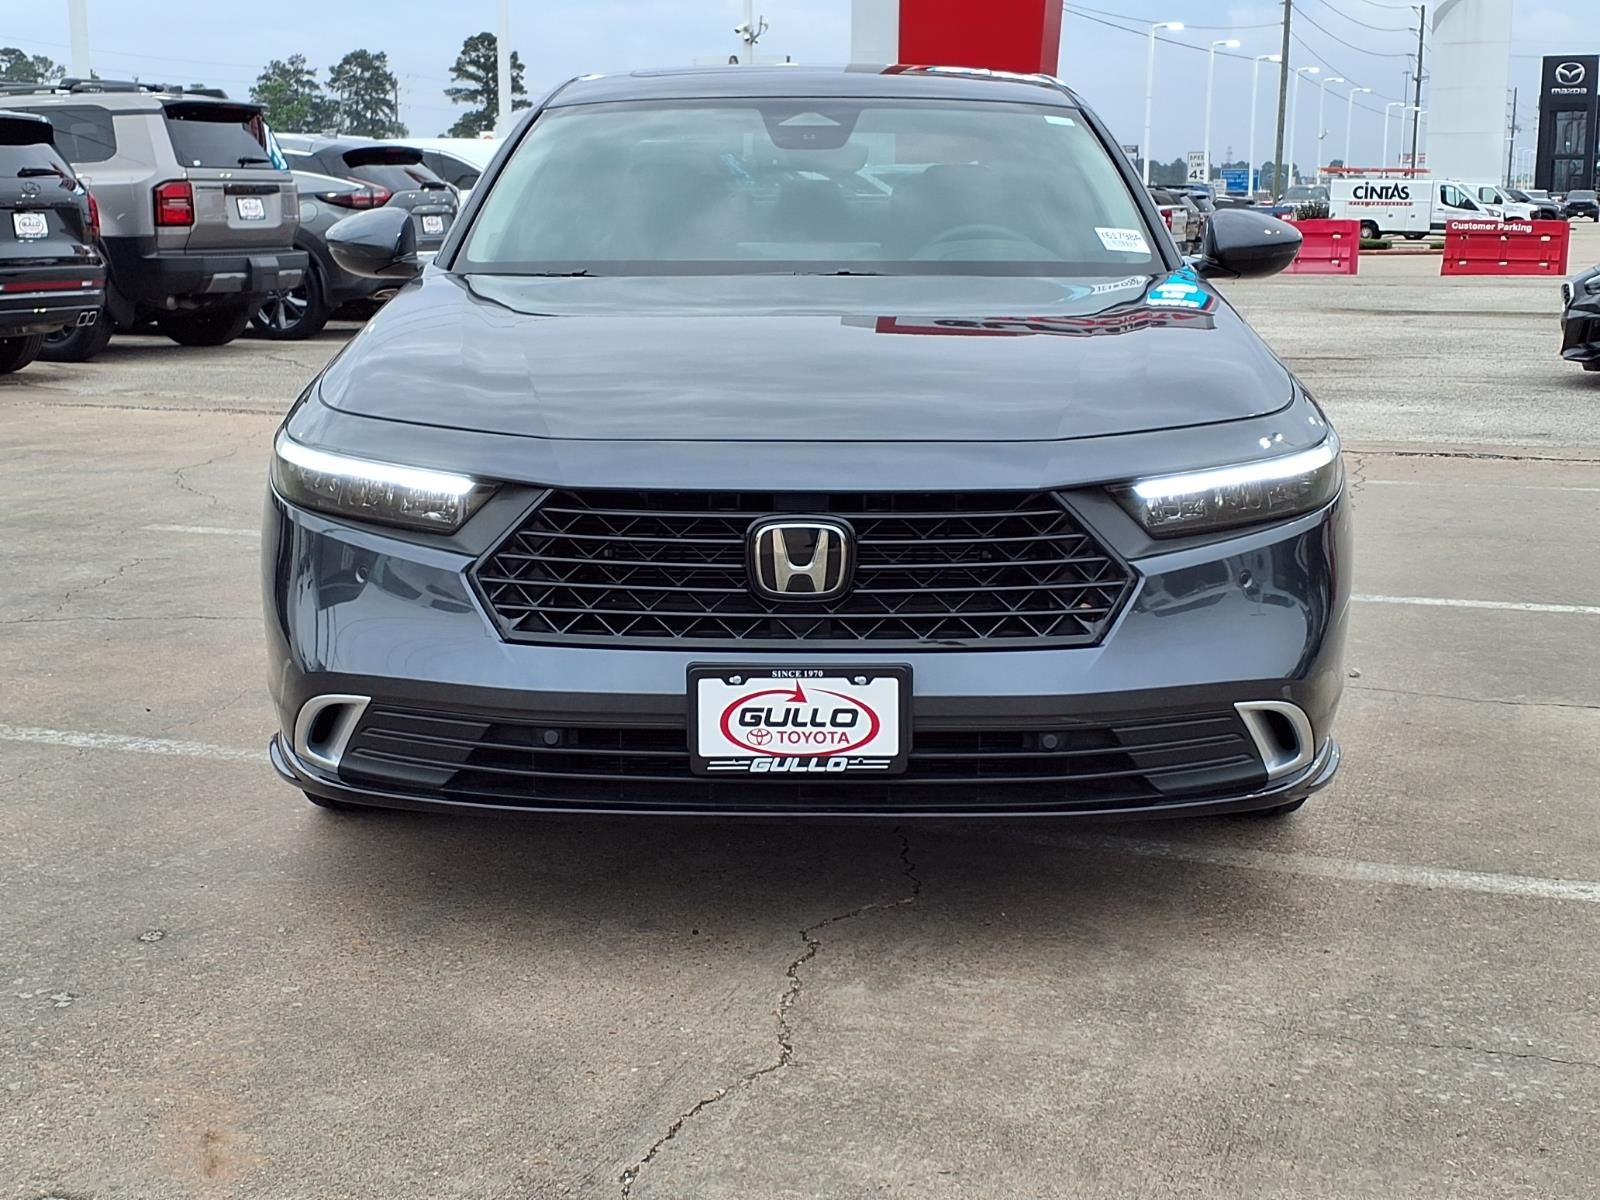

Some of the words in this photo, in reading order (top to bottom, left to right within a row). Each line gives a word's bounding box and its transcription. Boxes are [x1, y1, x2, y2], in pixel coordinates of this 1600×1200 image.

[1451, 222, 1496, 231] Customer
[1497, 222, 1533, 233] Parking
[771, 670, 802, 678] SINCE
[804, 670, 824, 678] 1970
[738, 707, 859, 728] GULLO
[776, 731, 850, 744] TOYOTA
[750, 757, 849, 773] GULLO
